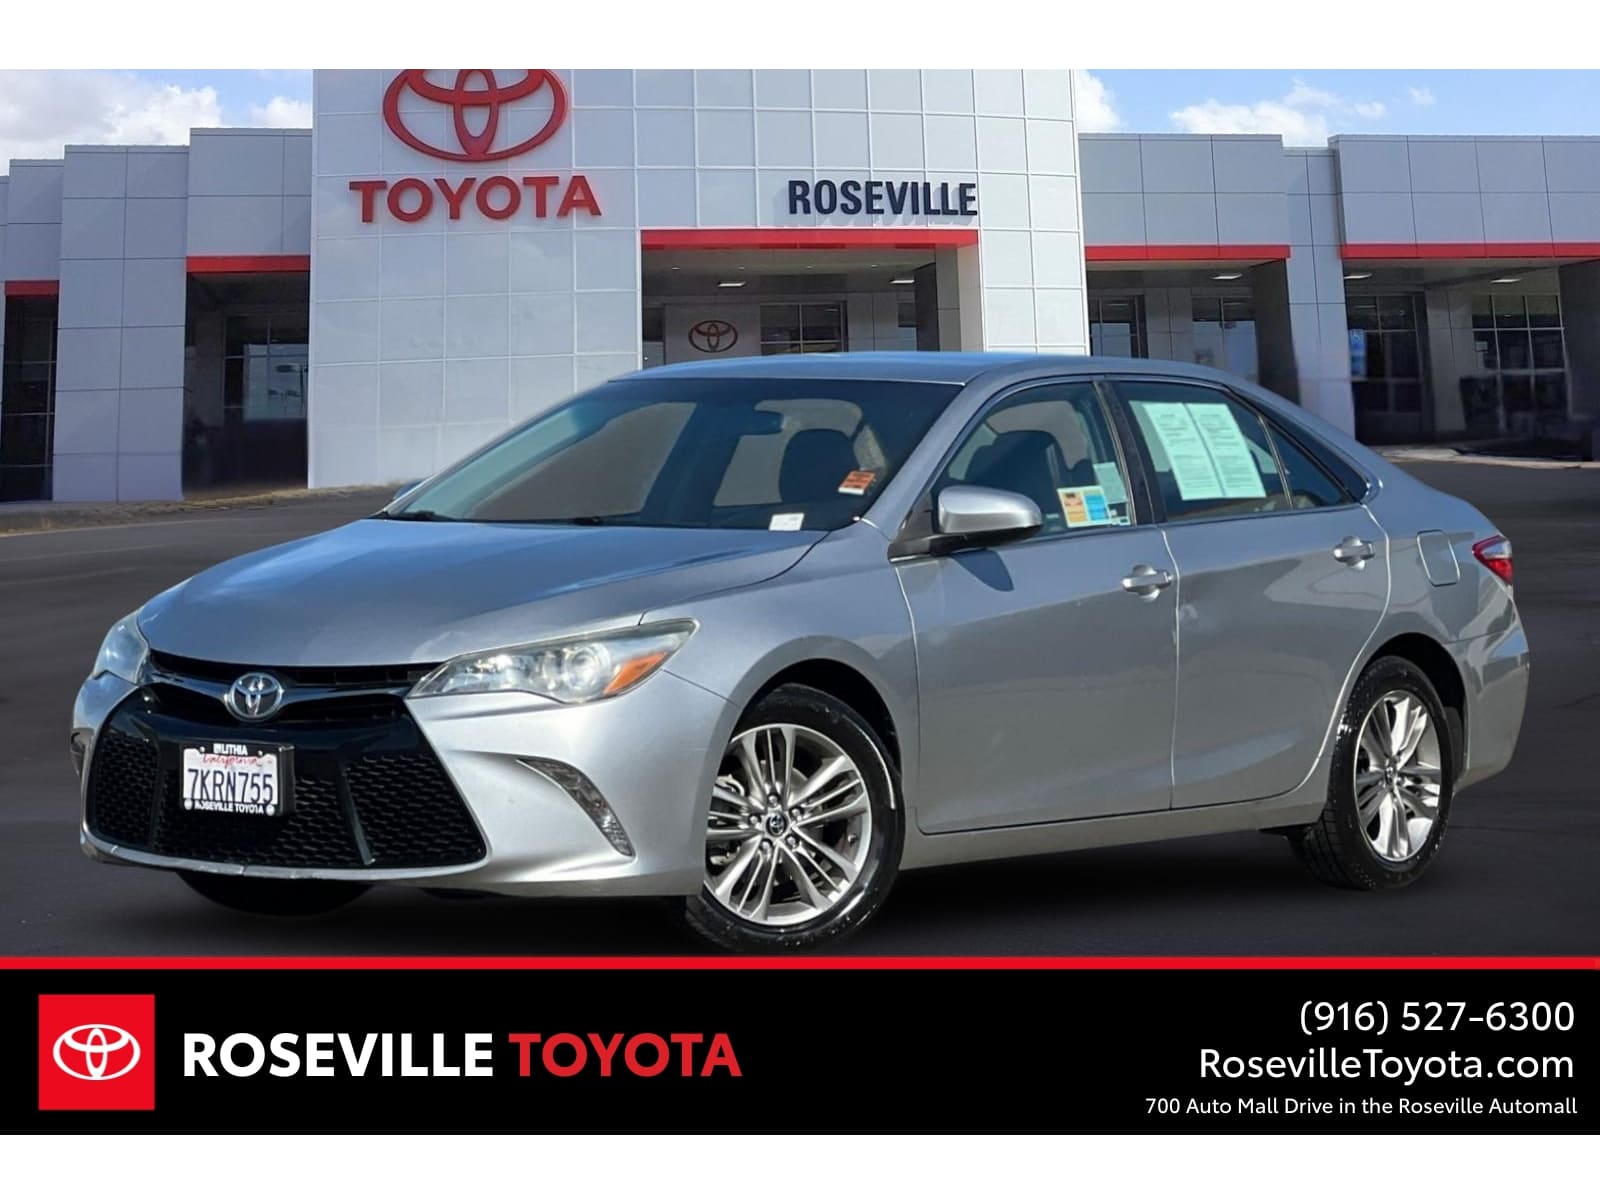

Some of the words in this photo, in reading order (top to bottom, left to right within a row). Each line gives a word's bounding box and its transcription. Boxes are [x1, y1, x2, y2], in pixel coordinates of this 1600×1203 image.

[349, 175, 602, 223] TOYOTA
[787, 179, 979, 217] ROSEVILLE
[220, 744, 248, 755] LITHIA
[188, 769, 273, 805] 7KRN755
[235, 803, 264, 814] TOYOTA
